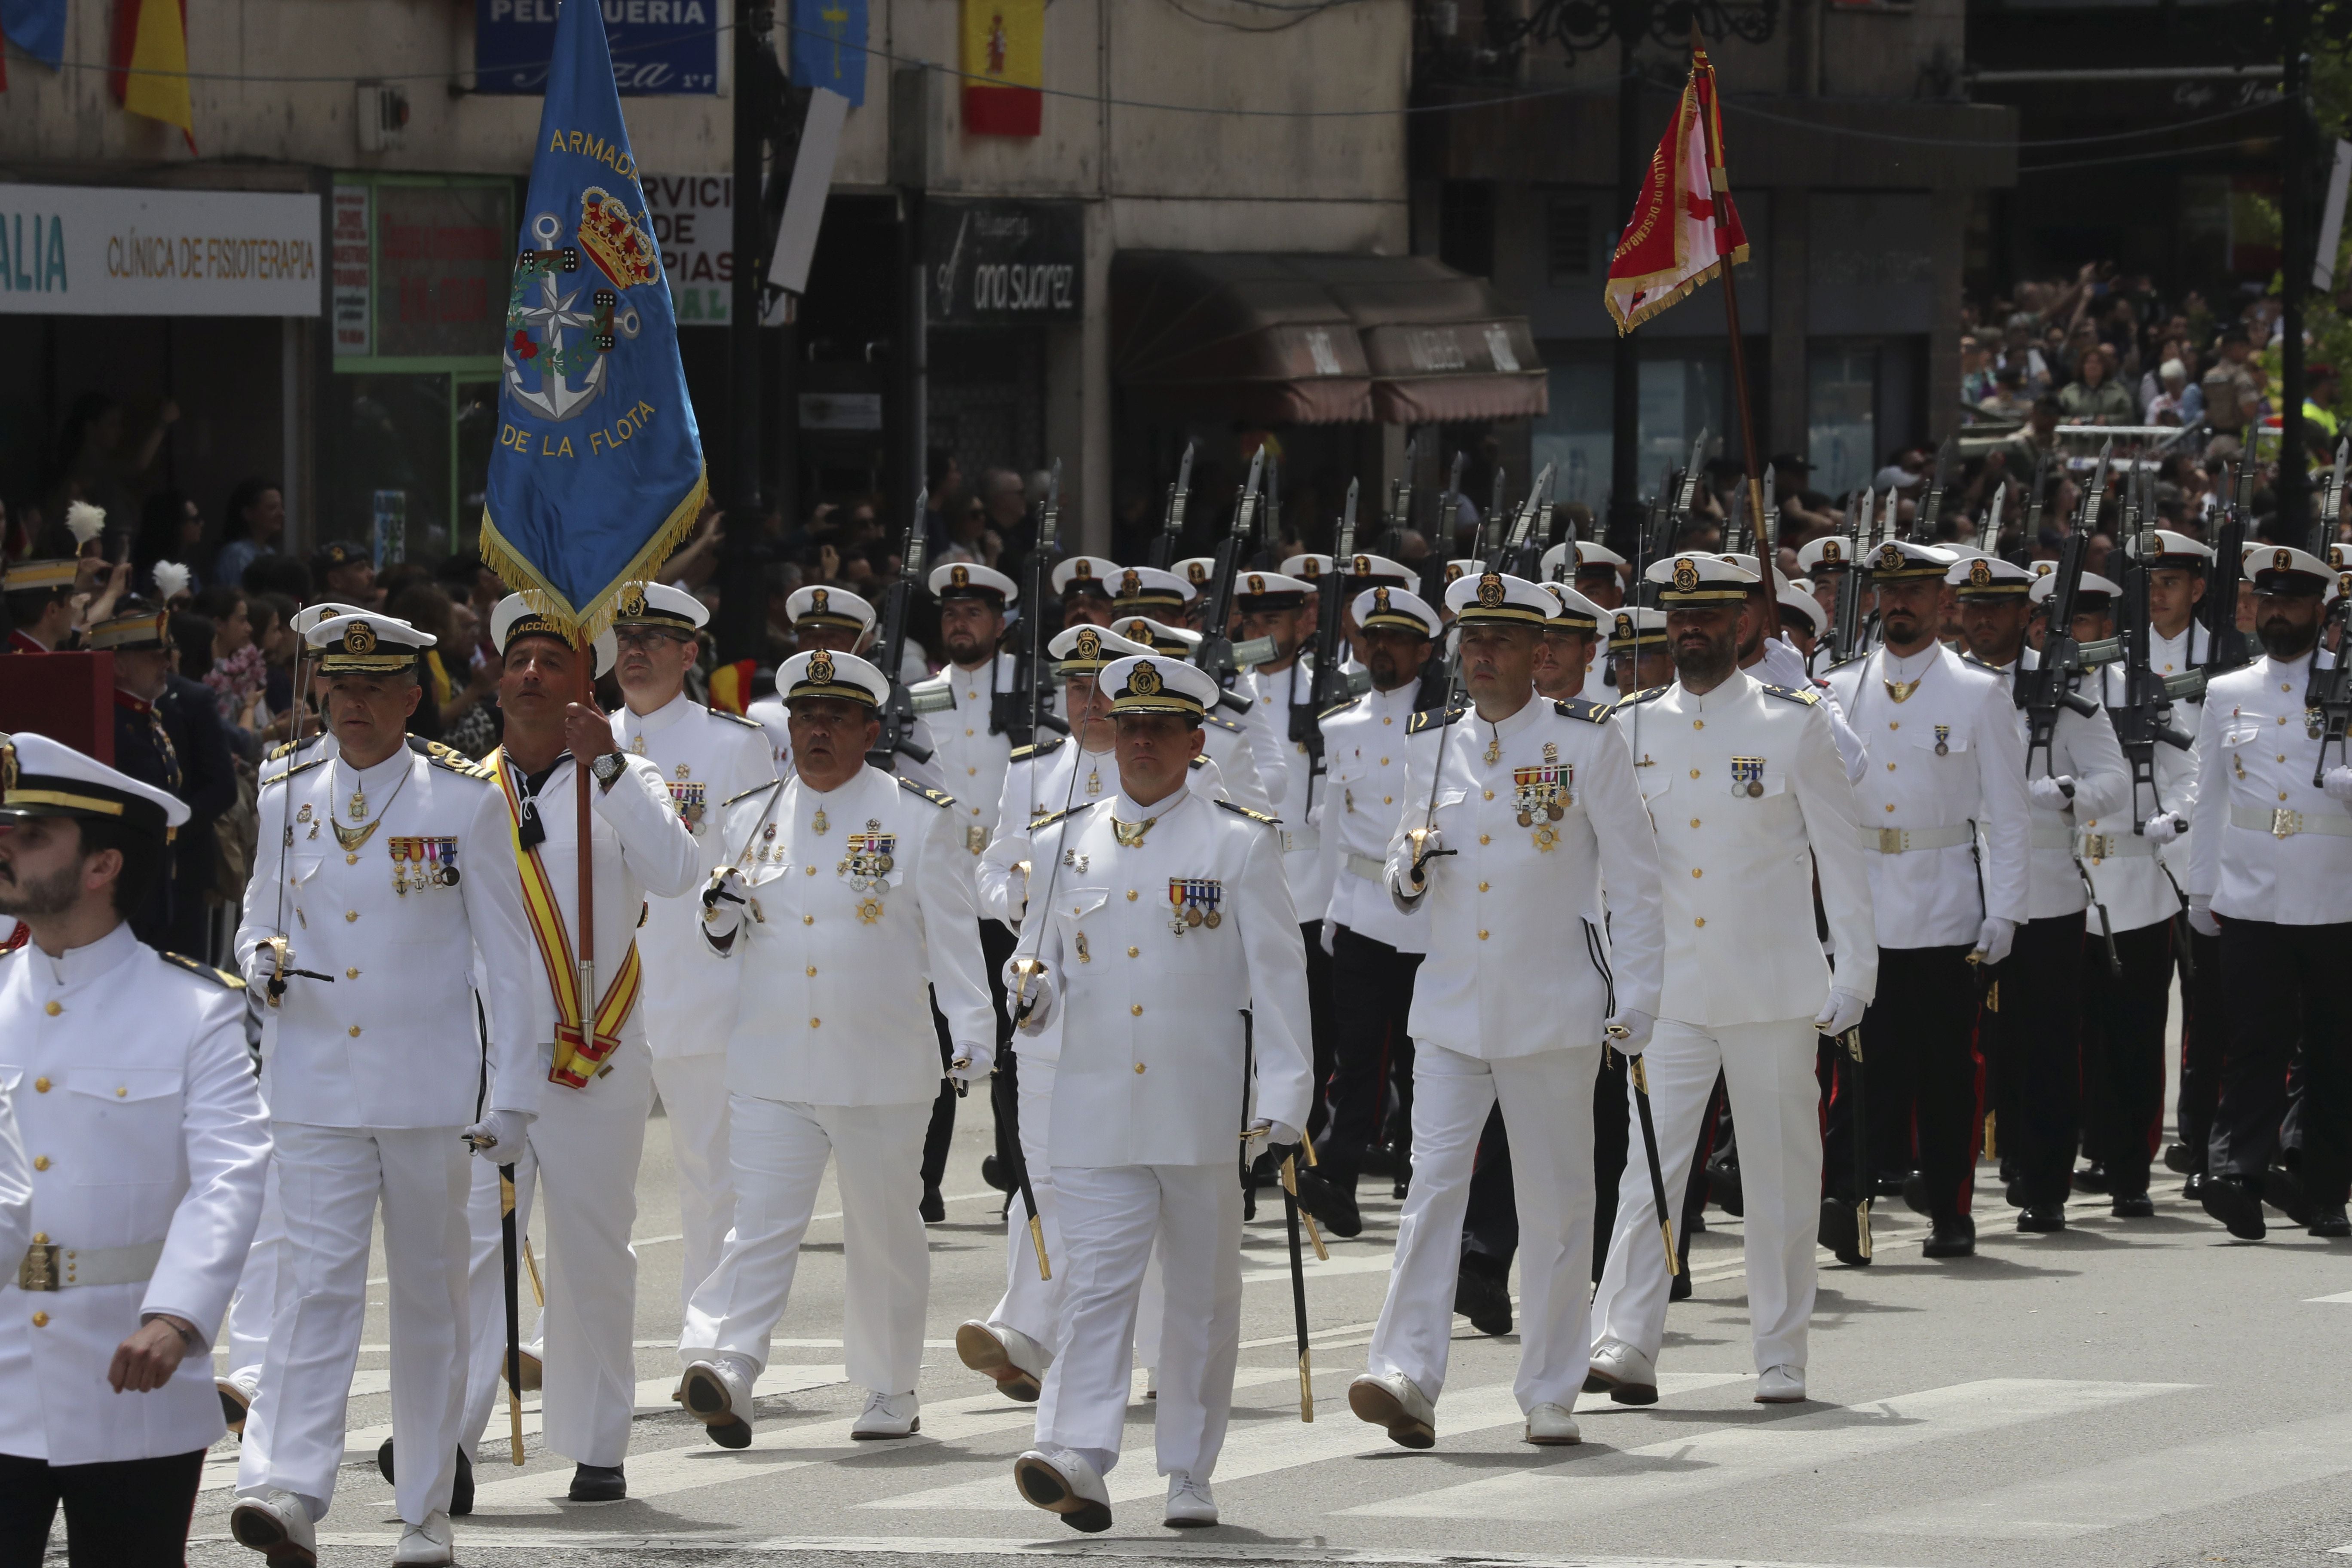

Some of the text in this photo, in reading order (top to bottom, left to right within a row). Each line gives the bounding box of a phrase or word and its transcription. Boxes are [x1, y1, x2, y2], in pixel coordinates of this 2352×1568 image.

[490, 0, 706, 24] PELUERIA
[550, 129, 638, 187] ARMADA
[1653, 190, 1663, 205] DE
[107, 227, 174, 279] CLÍNICA
[180, 237, 202, 279] DE
[207, 238, 315, 280] FISIOTERAPIA
[500, 400, 655, 458] DE LA FLOTA
